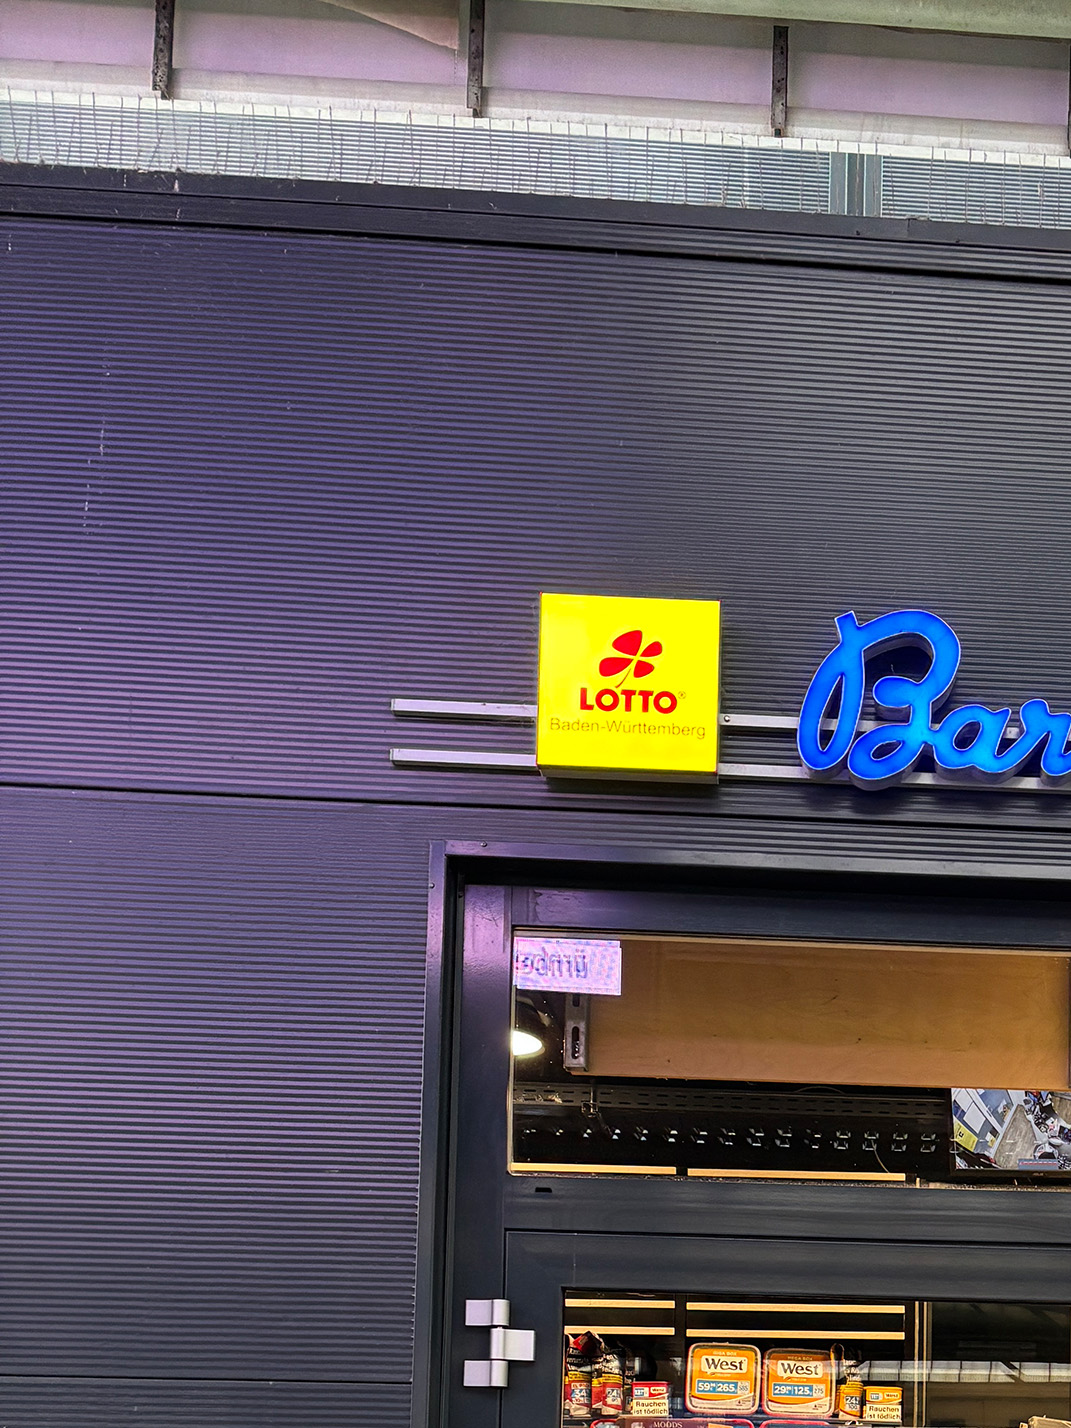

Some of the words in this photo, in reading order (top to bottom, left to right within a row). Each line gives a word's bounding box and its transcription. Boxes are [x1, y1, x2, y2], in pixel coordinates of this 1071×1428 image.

[580, 686, 678, 714] LOTTO
[549, 717, 706, 740] Baden-Württemberg
[705, 1358, 744, 1370] West
[781, 1362, 819, 1376] West
